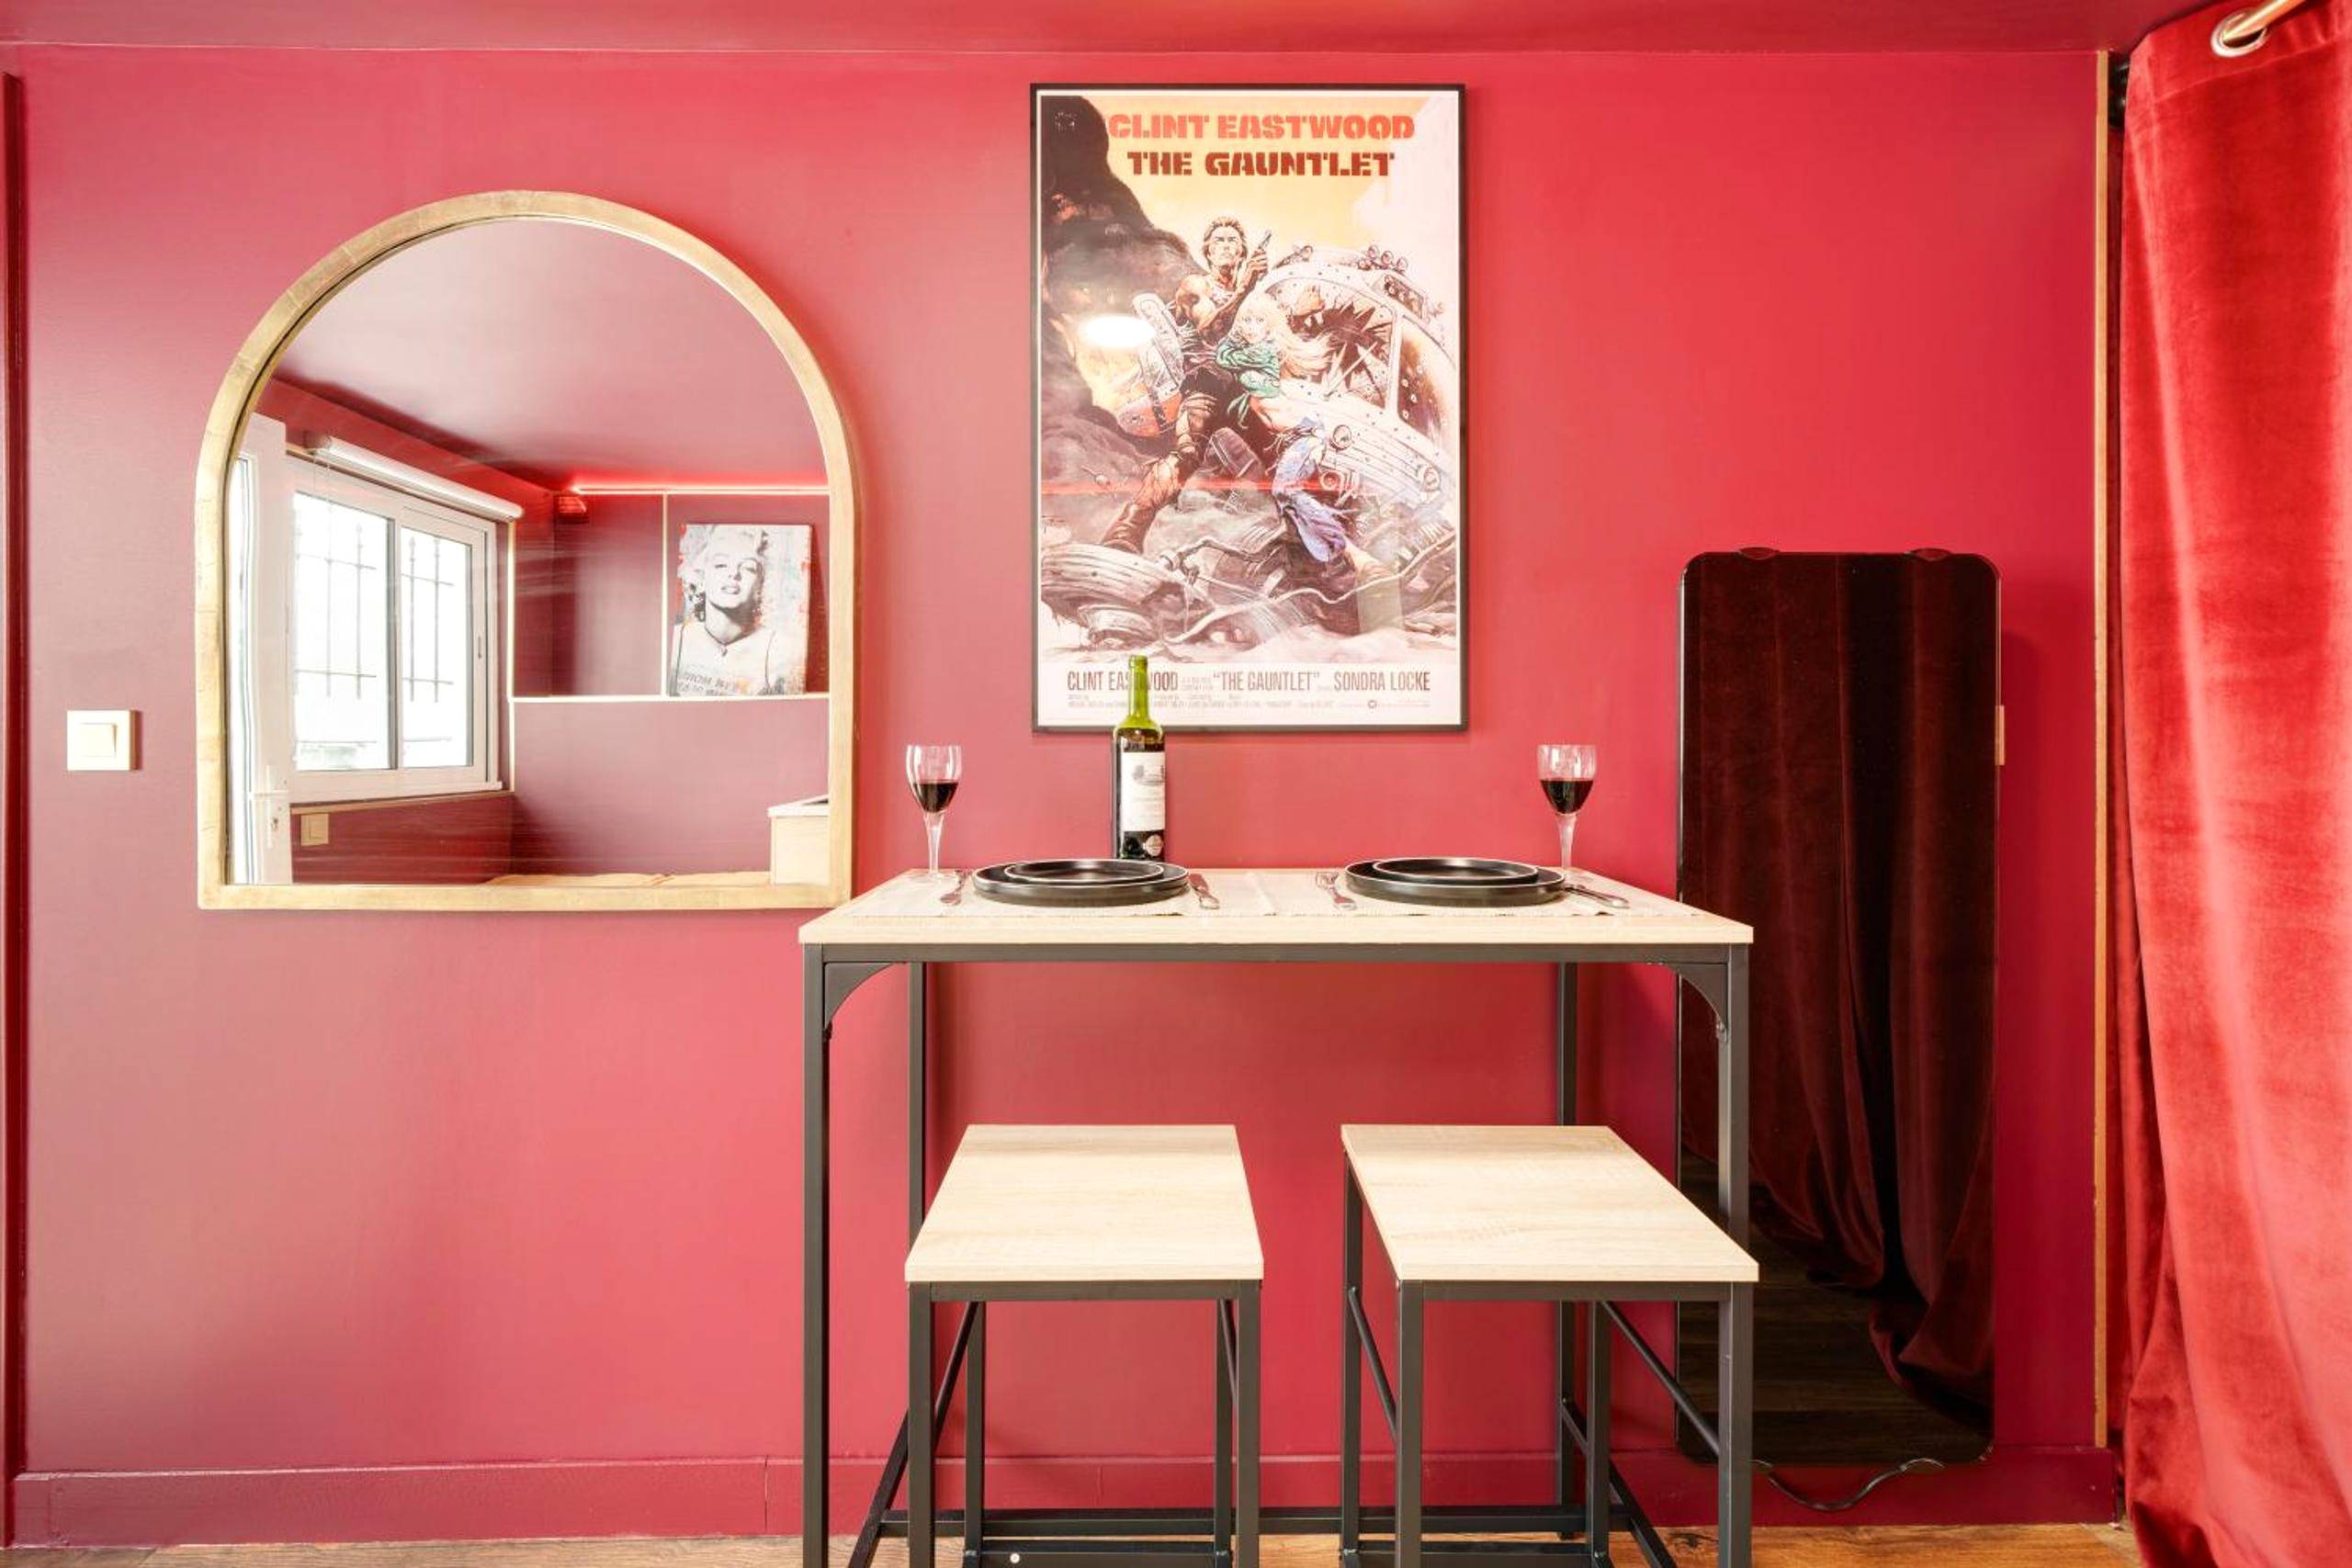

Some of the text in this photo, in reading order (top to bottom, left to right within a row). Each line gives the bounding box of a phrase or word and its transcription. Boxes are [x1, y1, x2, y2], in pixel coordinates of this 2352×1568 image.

[1108, 114, 1415, 139] CLINT EASTWOOD
[1126, 152, 1395, 176] THE GAUNTLET
[1067, 671, 1104, 691] CLINT
[1333, 671, 1386, 691] SONDRA
[1390, 671, 1431, 691] LOCKE
